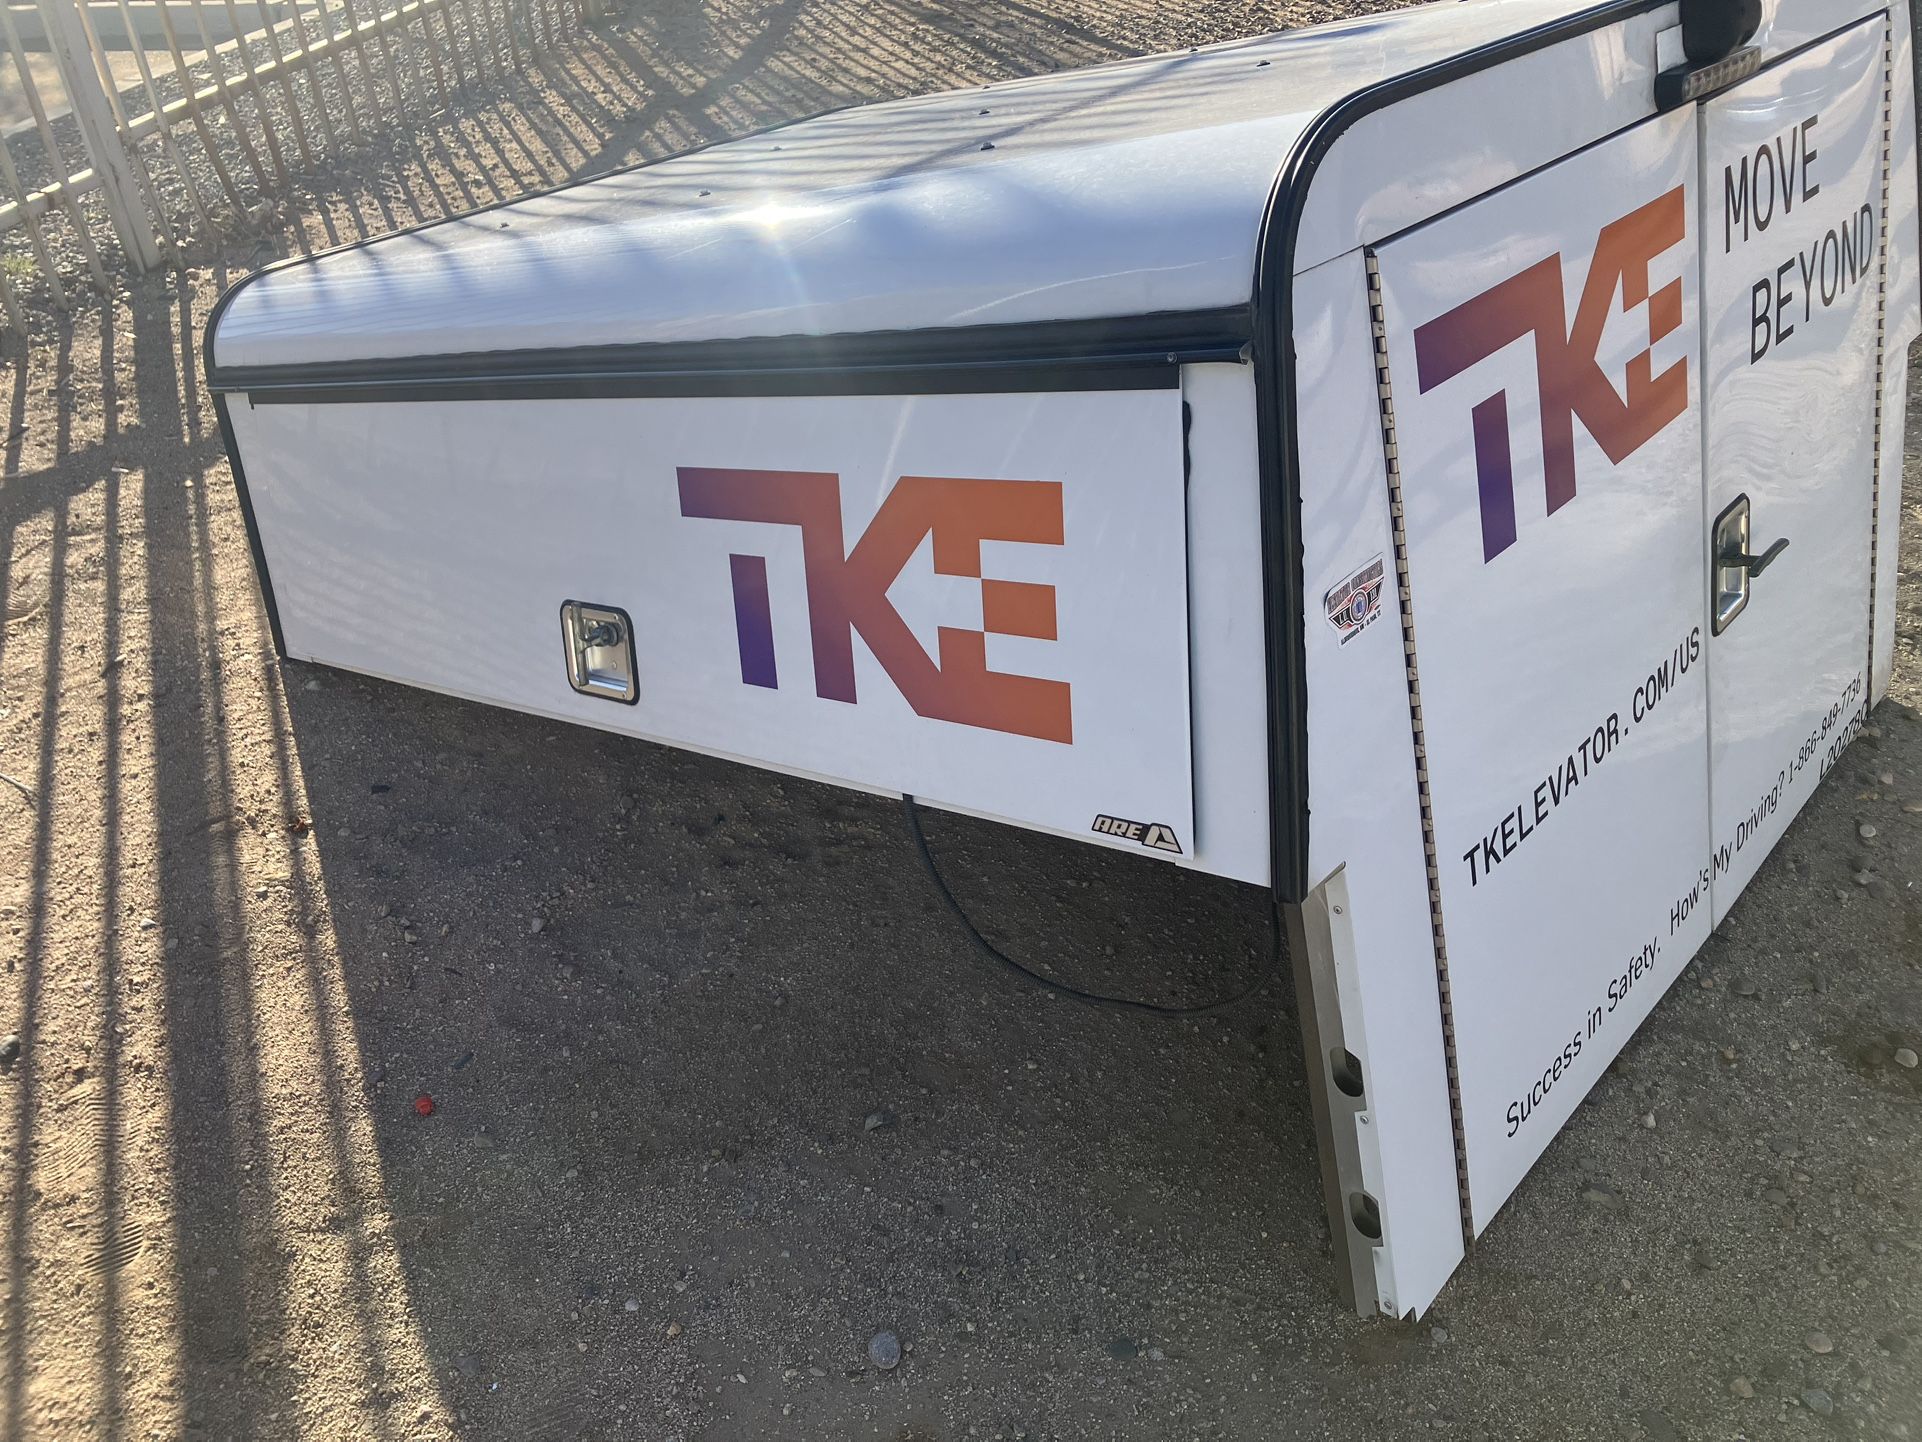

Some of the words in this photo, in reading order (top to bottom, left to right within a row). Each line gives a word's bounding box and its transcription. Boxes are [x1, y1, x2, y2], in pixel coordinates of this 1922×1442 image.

[1724, 114, 1820, 254] MOVE
[1750, 202, 1874, 365] BEYOND
[1413, 183, 1688, 564] TKE
[676, 466, 1073, 745] TKE
[1506, 1030, 1582, 1138] Success
[1587, 1005, 1603, 1040] in
[1607, 936, 1661, 1013] Safety.
[1670, 867, 1710, 936] How's
[1713, 838, 1732, 881] My
[1736, 770, 1785, 852] Driving?
[1788, 672, 1862, 784] 1-866-849-7736
